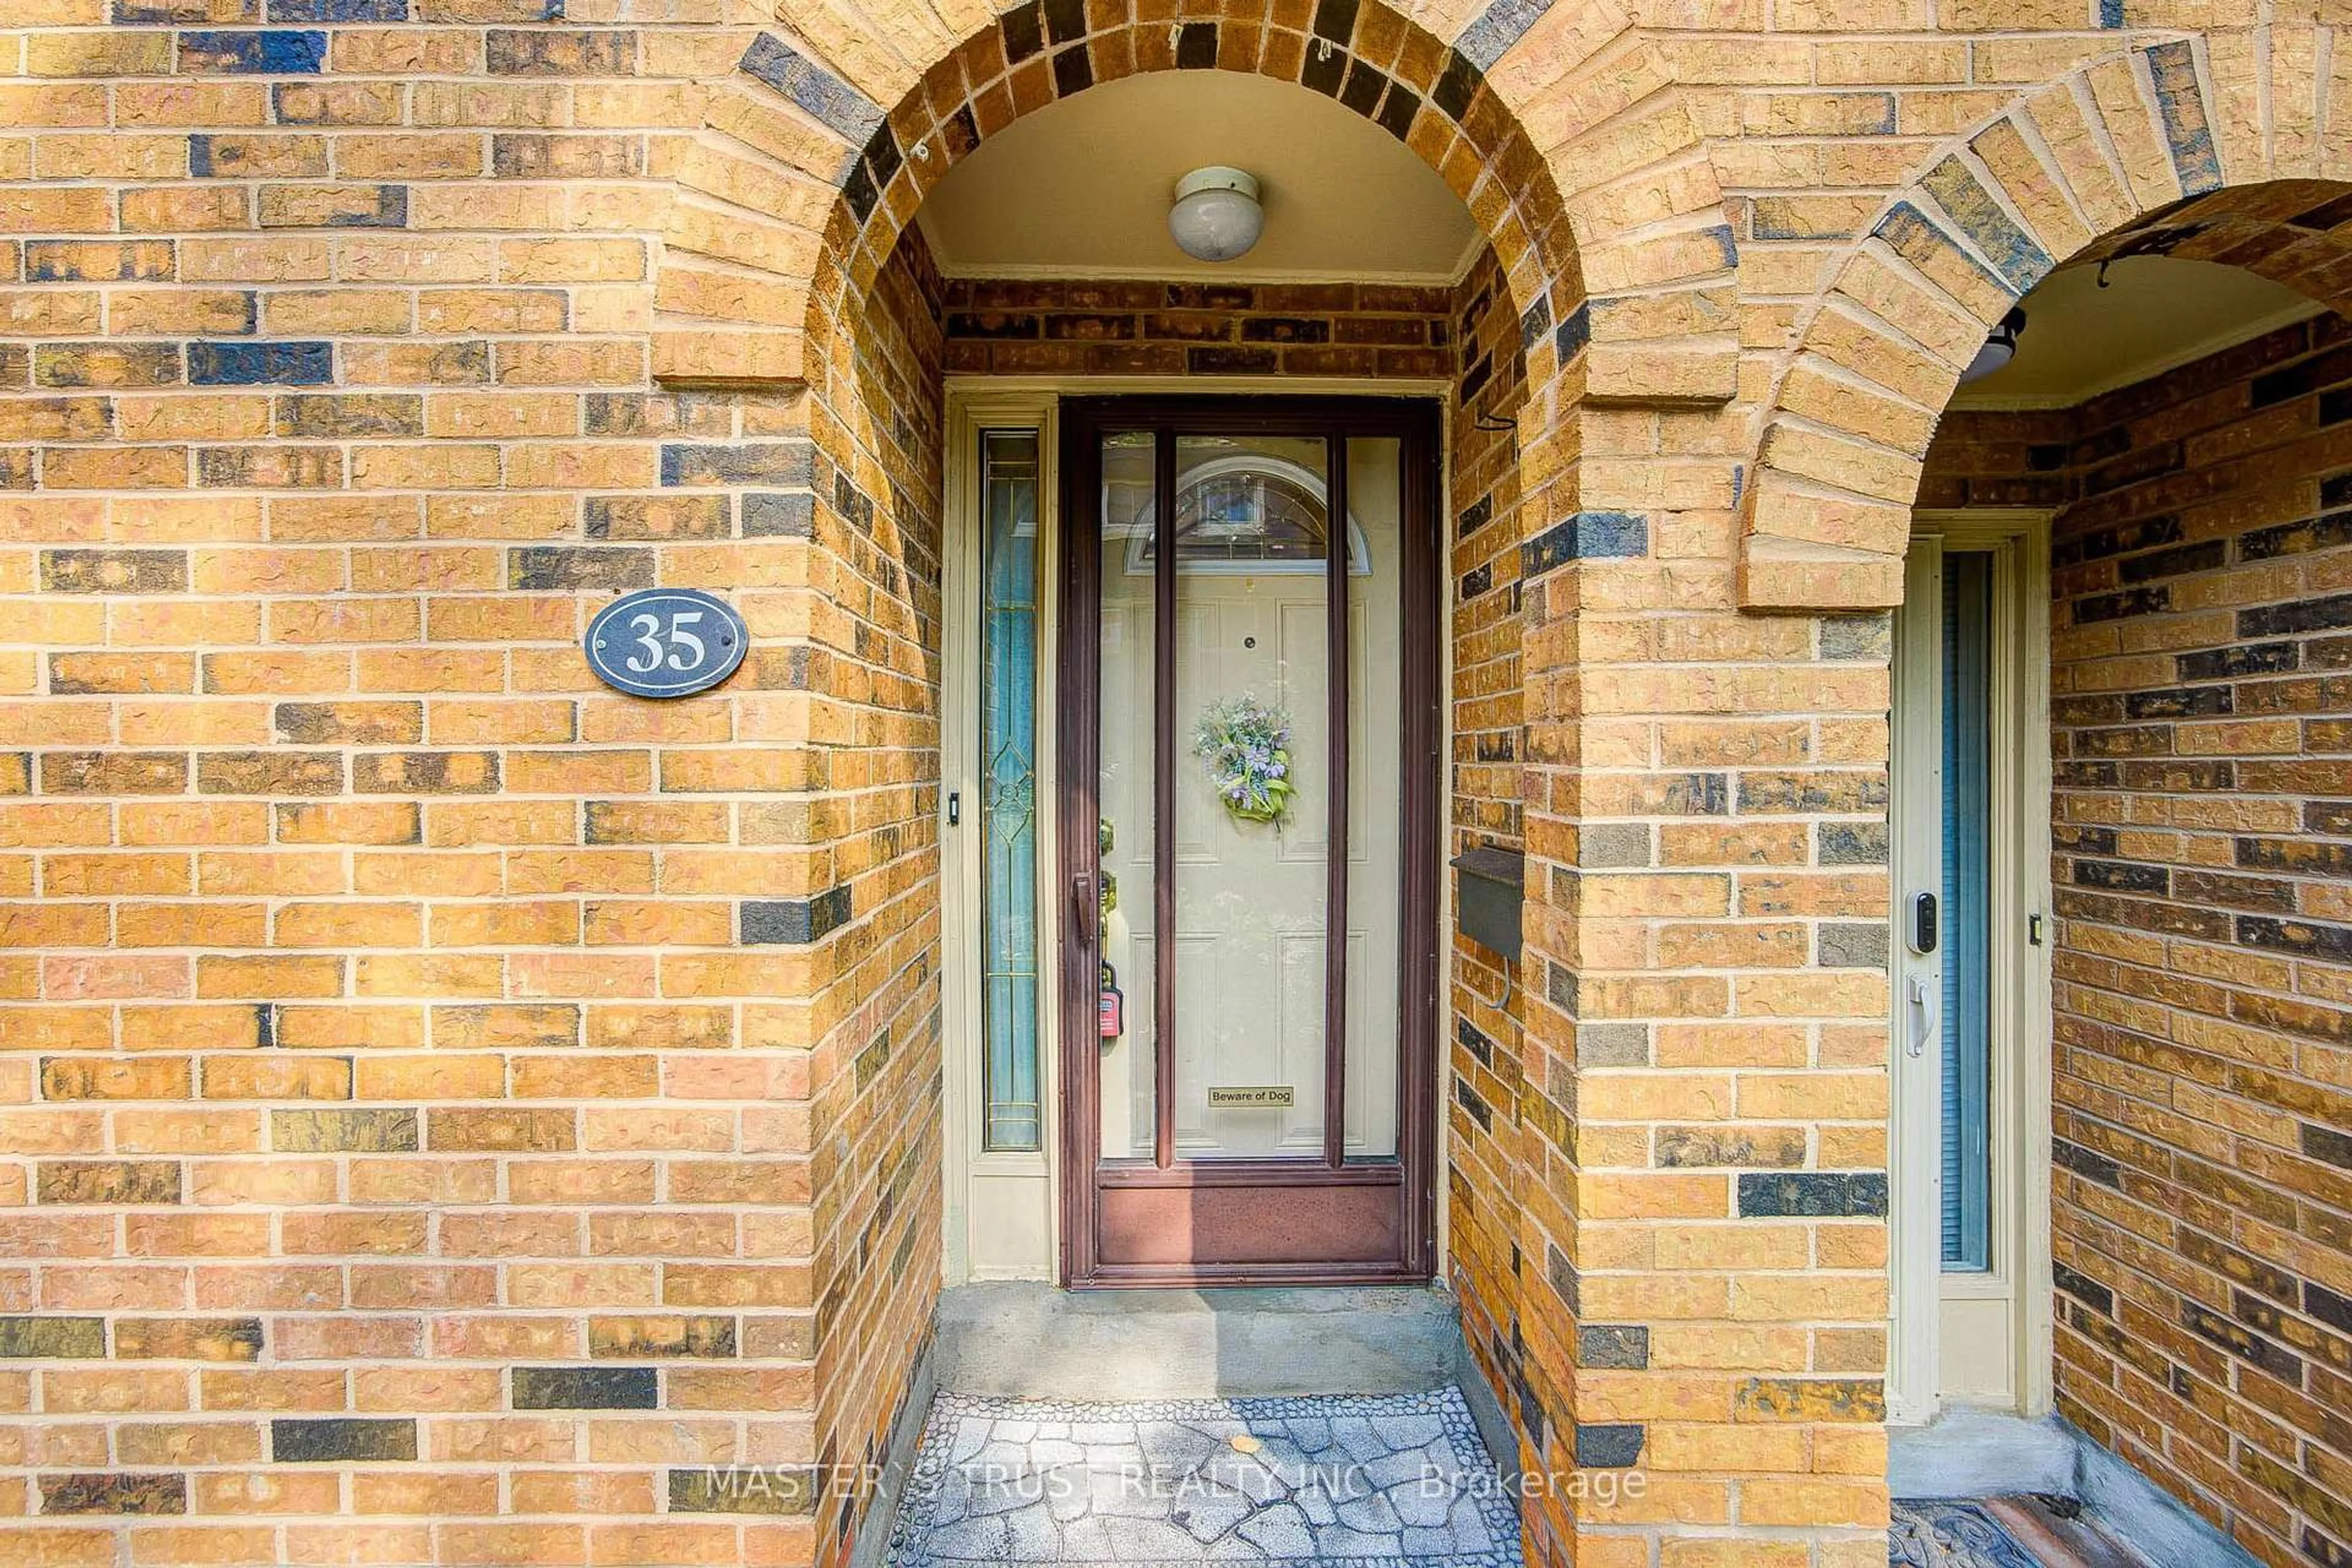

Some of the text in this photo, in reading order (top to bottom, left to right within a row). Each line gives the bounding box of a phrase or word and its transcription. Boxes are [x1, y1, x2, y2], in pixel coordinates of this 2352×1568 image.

[627, 612, 705, 673] 35
[1213, 1091, 1291, 1102] Beware of Dog
